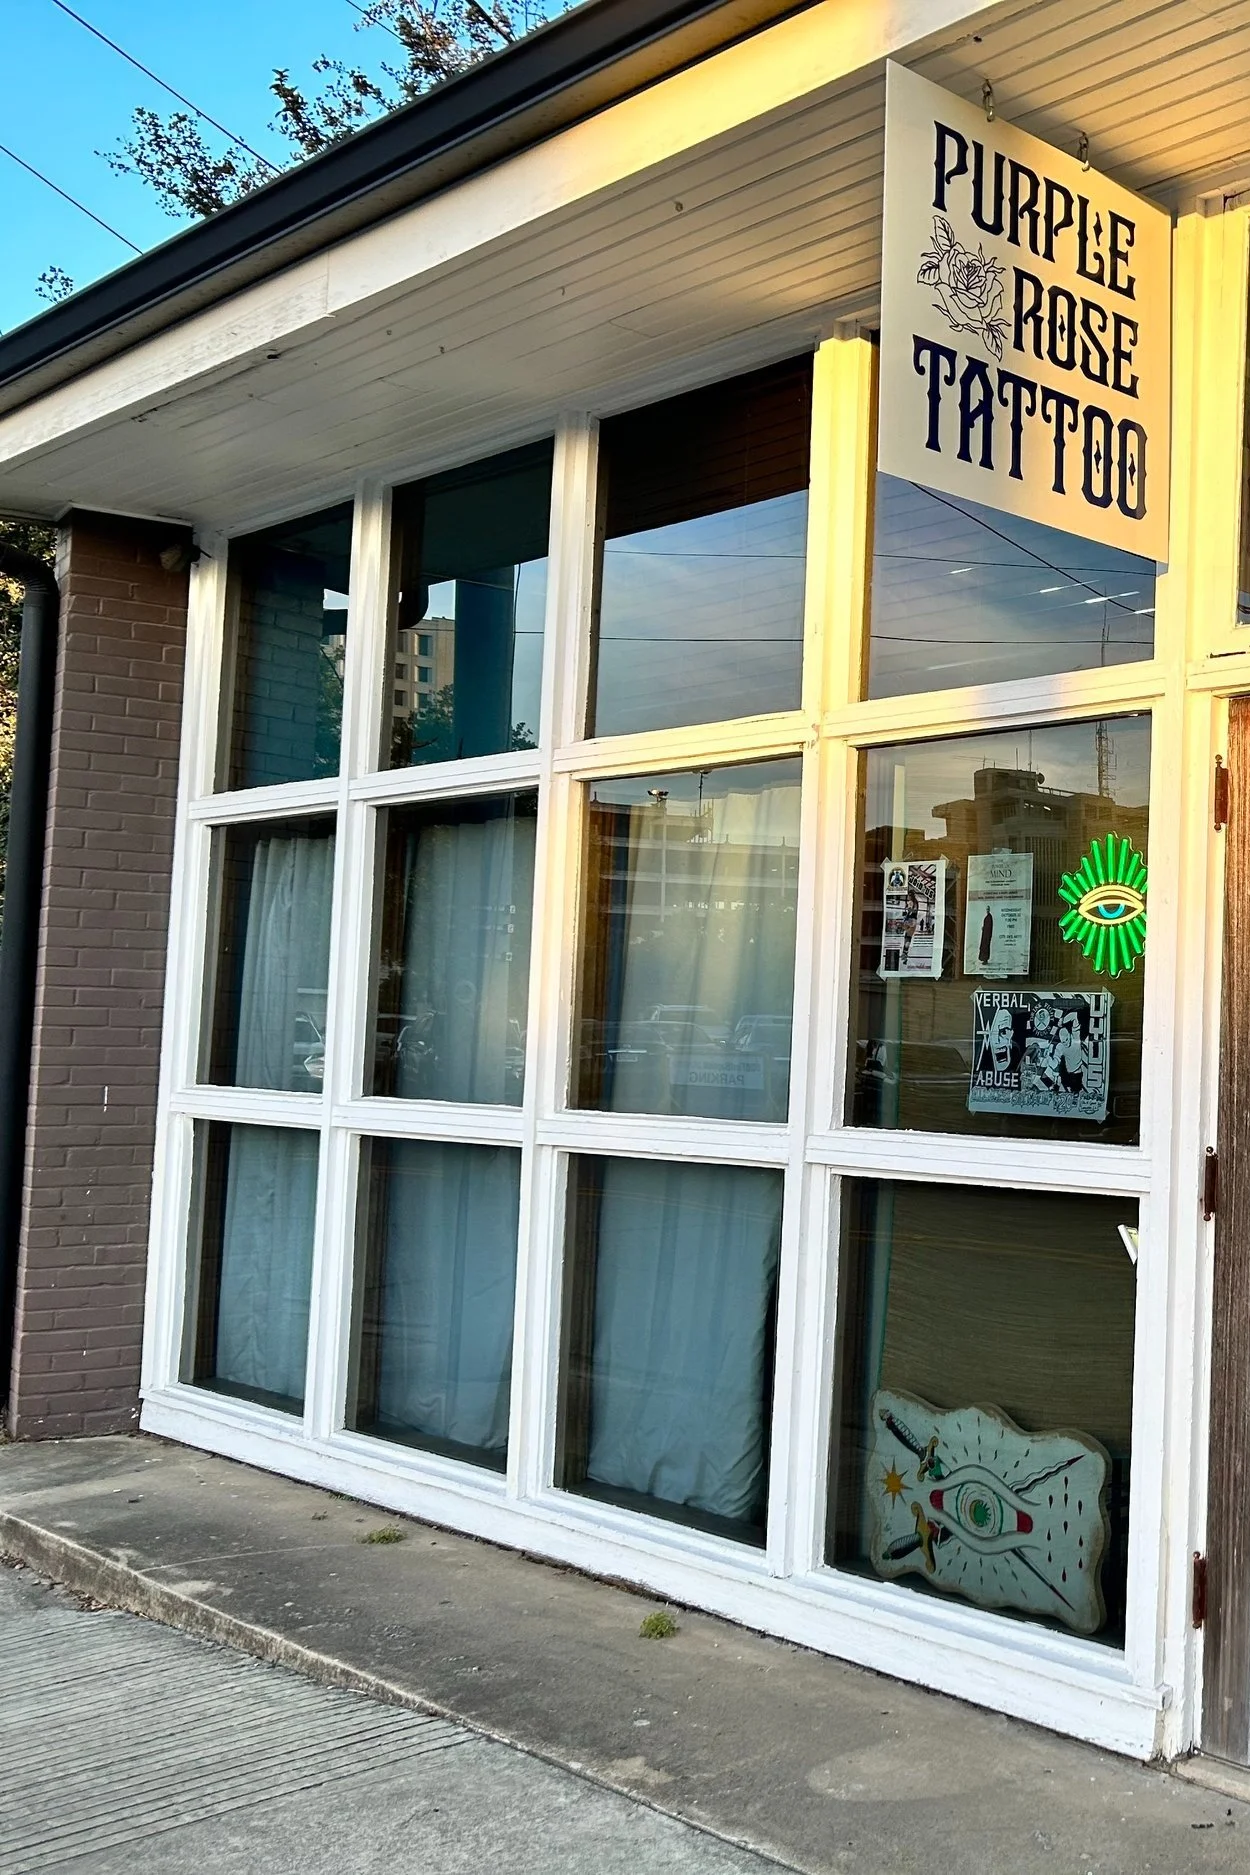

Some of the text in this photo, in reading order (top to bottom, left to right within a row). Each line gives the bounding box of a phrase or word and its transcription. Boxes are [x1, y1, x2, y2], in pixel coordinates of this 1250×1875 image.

[932, 120, 1136, 300] PURPLE
[1013, 266, 1139, 399] ROSE
[912, 334, 1148, 521] TATTOO
[975, 1070, 1019, 1088] ABUSE
